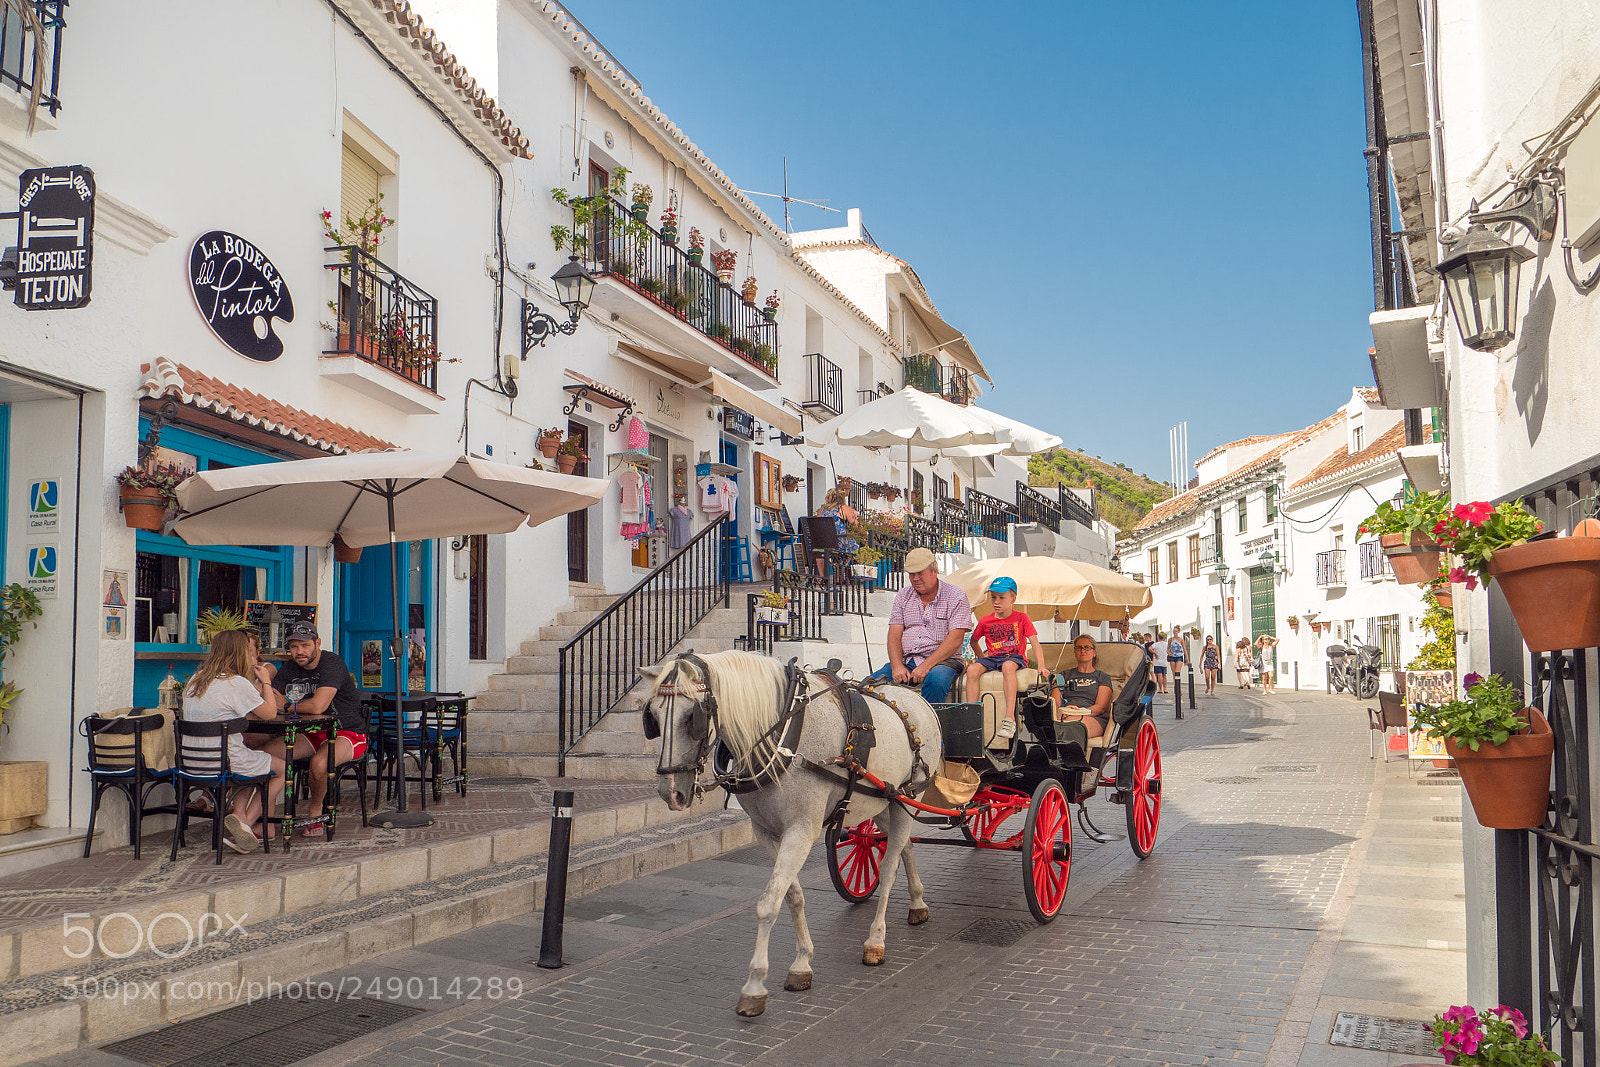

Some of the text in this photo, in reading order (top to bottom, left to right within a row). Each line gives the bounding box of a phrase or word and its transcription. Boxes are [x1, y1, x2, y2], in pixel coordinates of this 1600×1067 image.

[19, 176, 42, 207] GUEST
[17, 250, 87, 273] HOSPEDAJE
[195, 260, 216, 285] del
[200, 234, 283, 297] LA BODEGA
[20, 275, 84, 304] TEJON
[210, 256, 281, 324] Pintor
